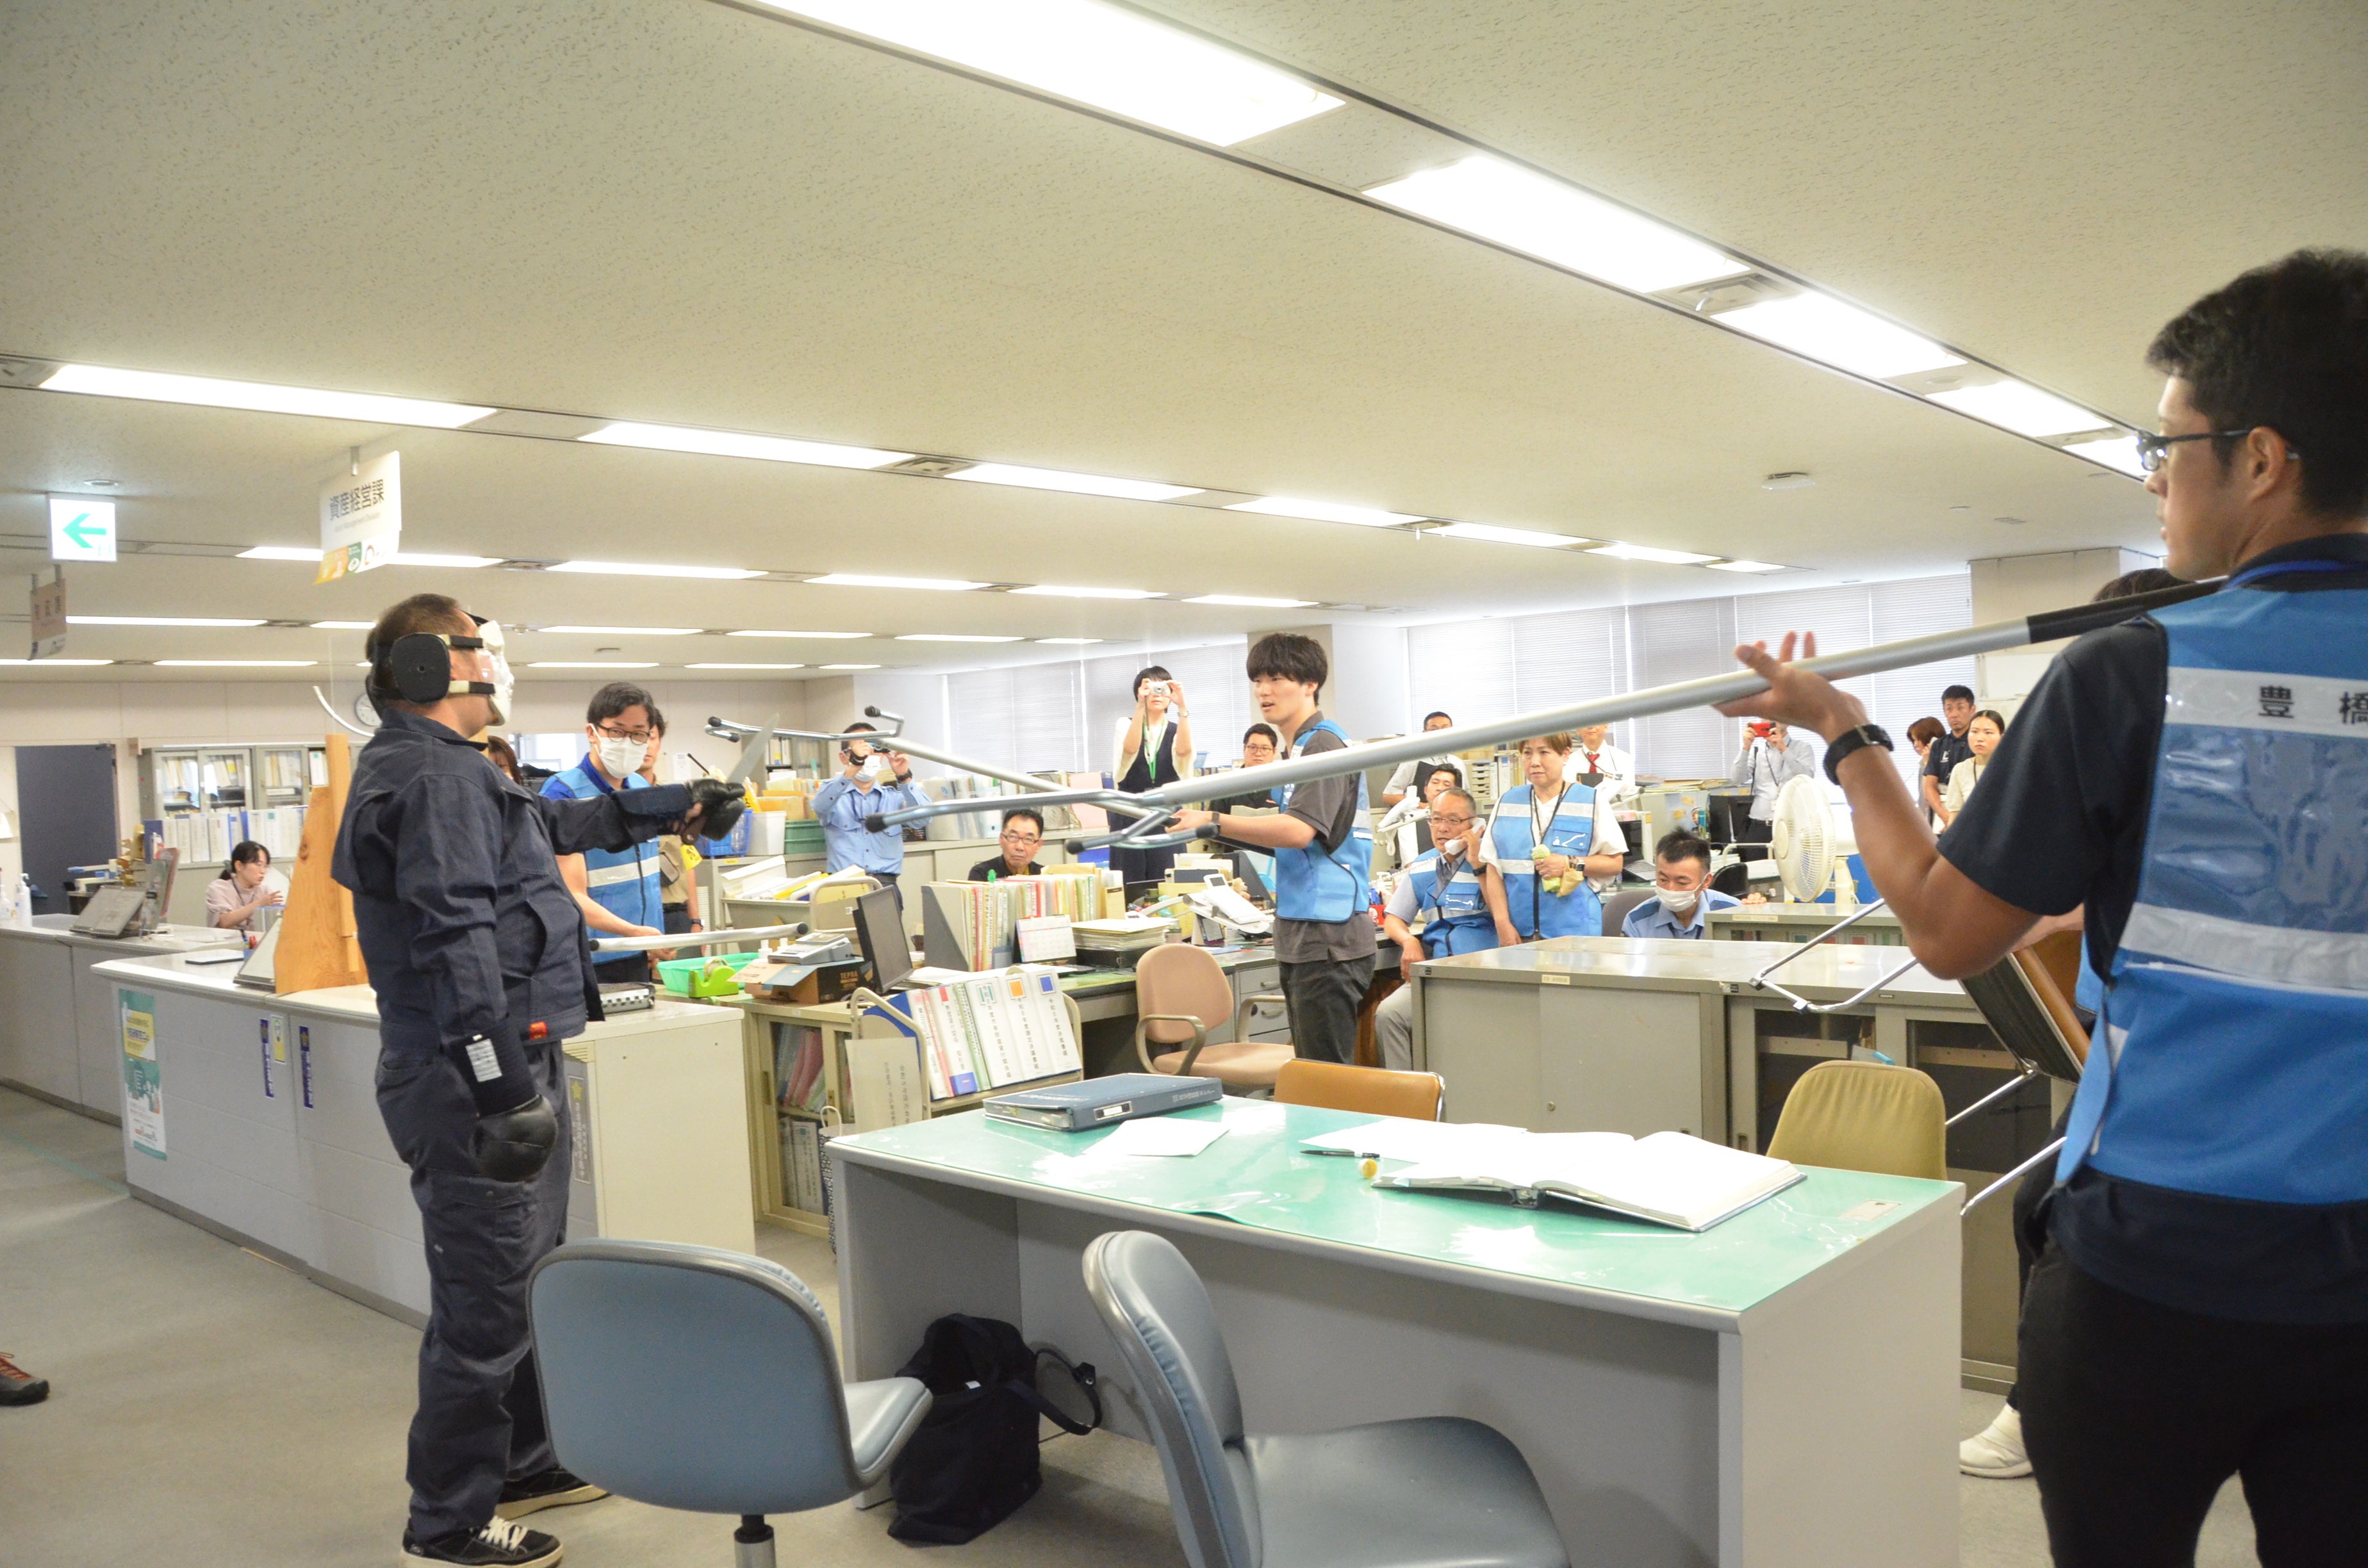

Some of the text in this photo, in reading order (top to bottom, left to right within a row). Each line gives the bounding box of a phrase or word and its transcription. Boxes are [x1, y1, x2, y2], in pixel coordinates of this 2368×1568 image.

[329, 478, 384, 521] 資産経営課
[2258, 685, 2368, 724] 豊橋
